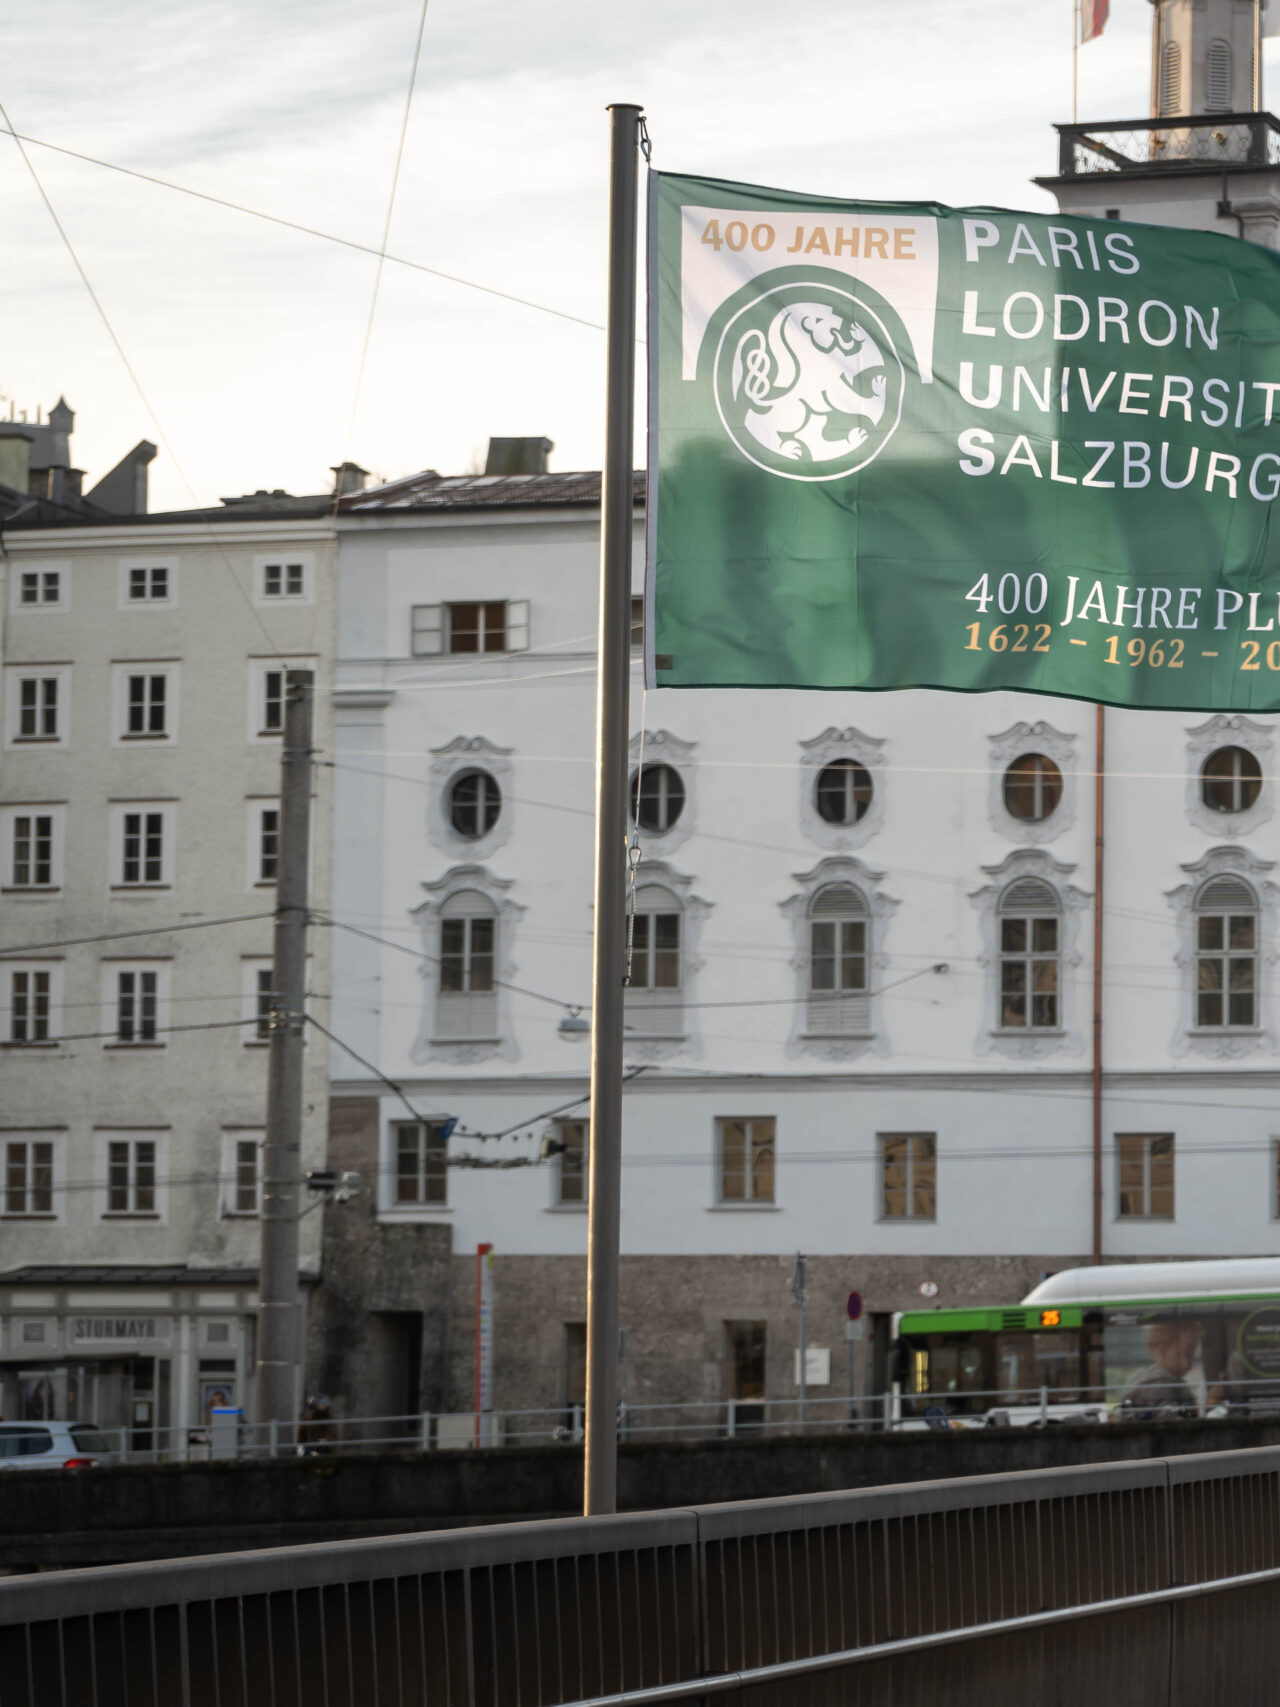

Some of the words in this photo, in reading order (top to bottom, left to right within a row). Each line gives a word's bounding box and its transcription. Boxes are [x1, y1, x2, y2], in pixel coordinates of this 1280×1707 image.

[700, 219, 776, 252] 400
[785, 225, 917, 260] JAHRE
[961, 217, 1141, 275] PARIS
[960, 289, 1220, 350] LODRON
[965, 572, 1049, 615] 400
[1059, 576, 1202, 630] JAHRE
[963, 622, 1052, 653] 1622
[1103, 634, 1185, 669] 1962
